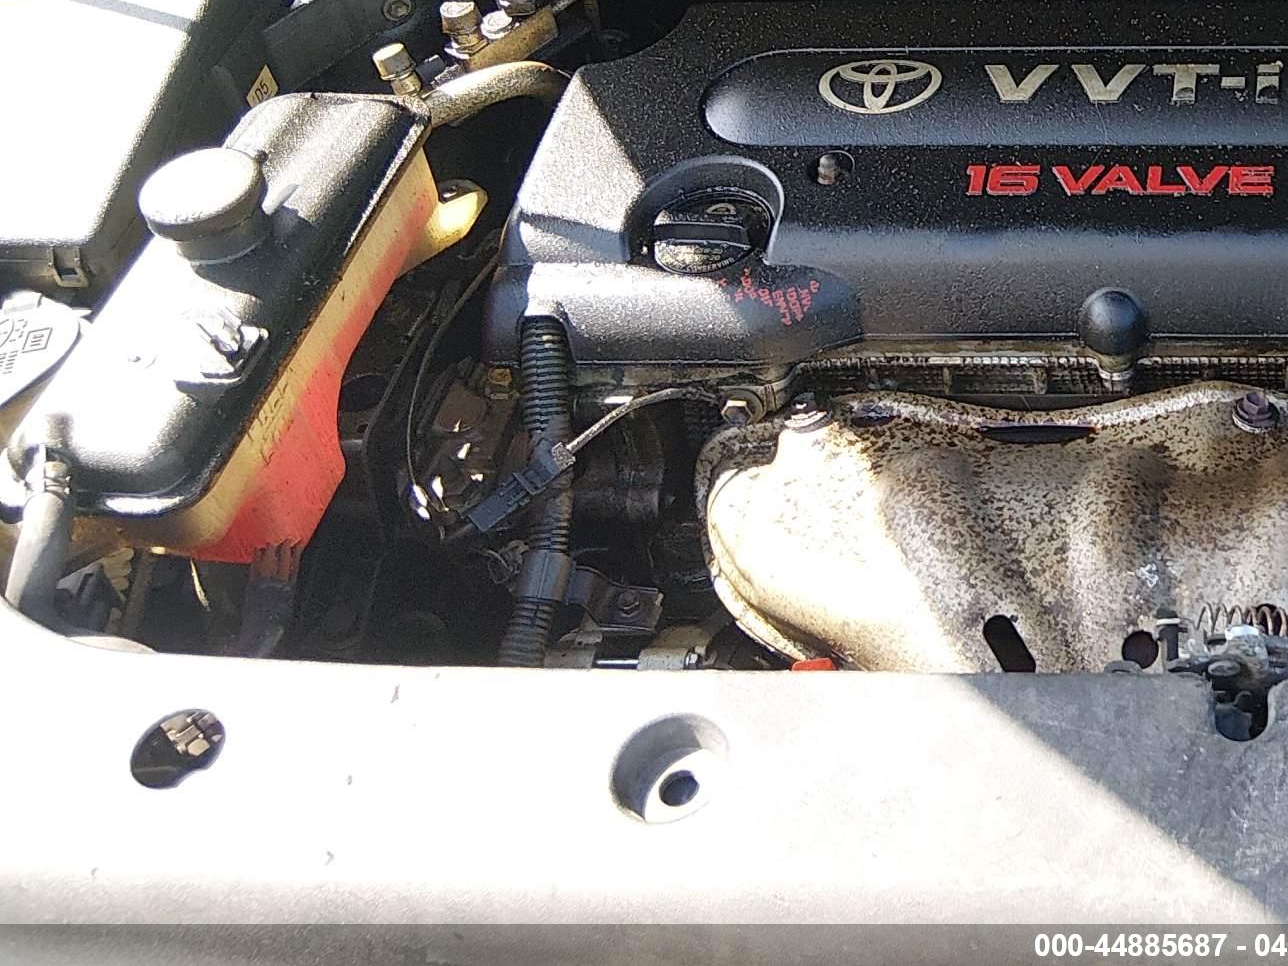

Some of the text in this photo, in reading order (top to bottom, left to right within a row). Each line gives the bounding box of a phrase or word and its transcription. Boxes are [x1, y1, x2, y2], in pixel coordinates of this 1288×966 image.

[984, 61, 1284, 104] VVT-i
[967, 165, 1275, 196] 16 VALVE
